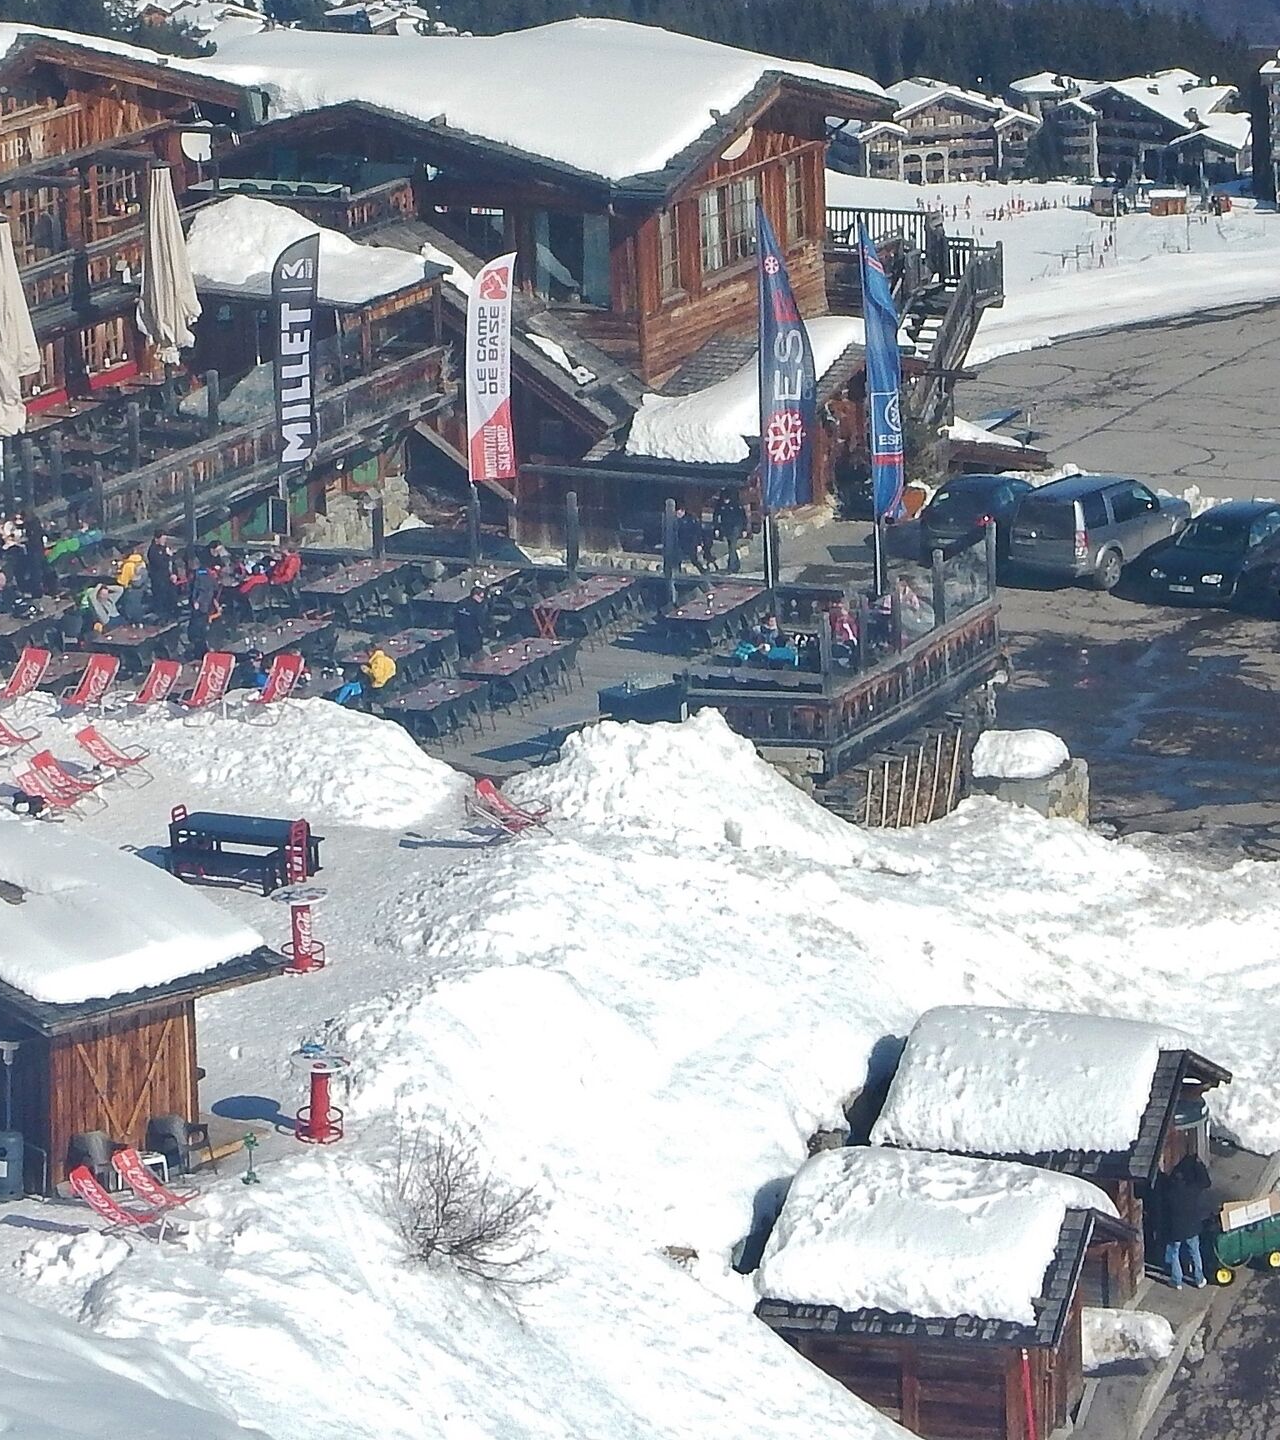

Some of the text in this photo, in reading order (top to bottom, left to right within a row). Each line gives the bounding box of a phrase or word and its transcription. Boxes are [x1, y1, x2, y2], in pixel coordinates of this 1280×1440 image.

[281, 302, 312, 462] MILLET
[477, 306, 487, 395] LE CAMP
[489, 306, 500, 395] DE BASE
[483, 425, 498, 478] MOUNTAIN
[497, 425, 511, 472] SKI SHOP
